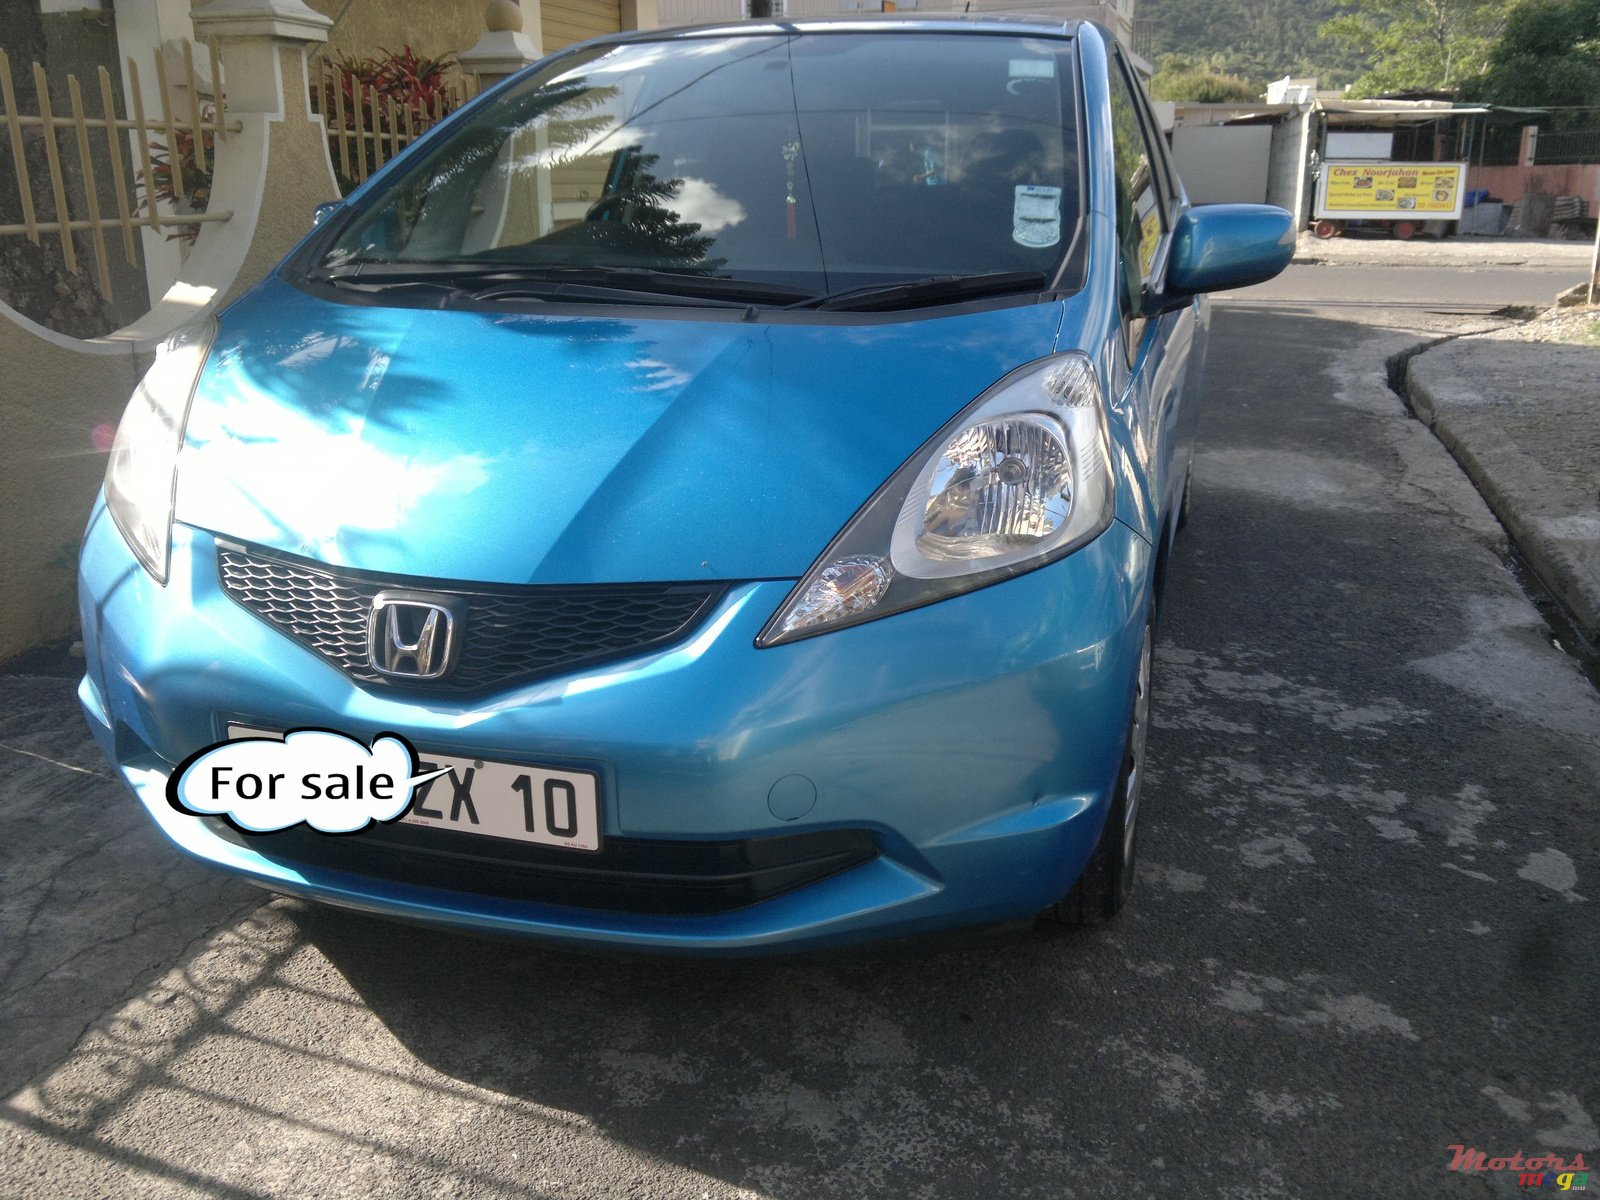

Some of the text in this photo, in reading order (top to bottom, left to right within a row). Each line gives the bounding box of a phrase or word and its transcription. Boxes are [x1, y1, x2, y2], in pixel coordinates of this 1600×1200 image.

[1333, 168, 1419, 178] Chez Noorjahan
[413, 762, 579, 838] ZX 10
